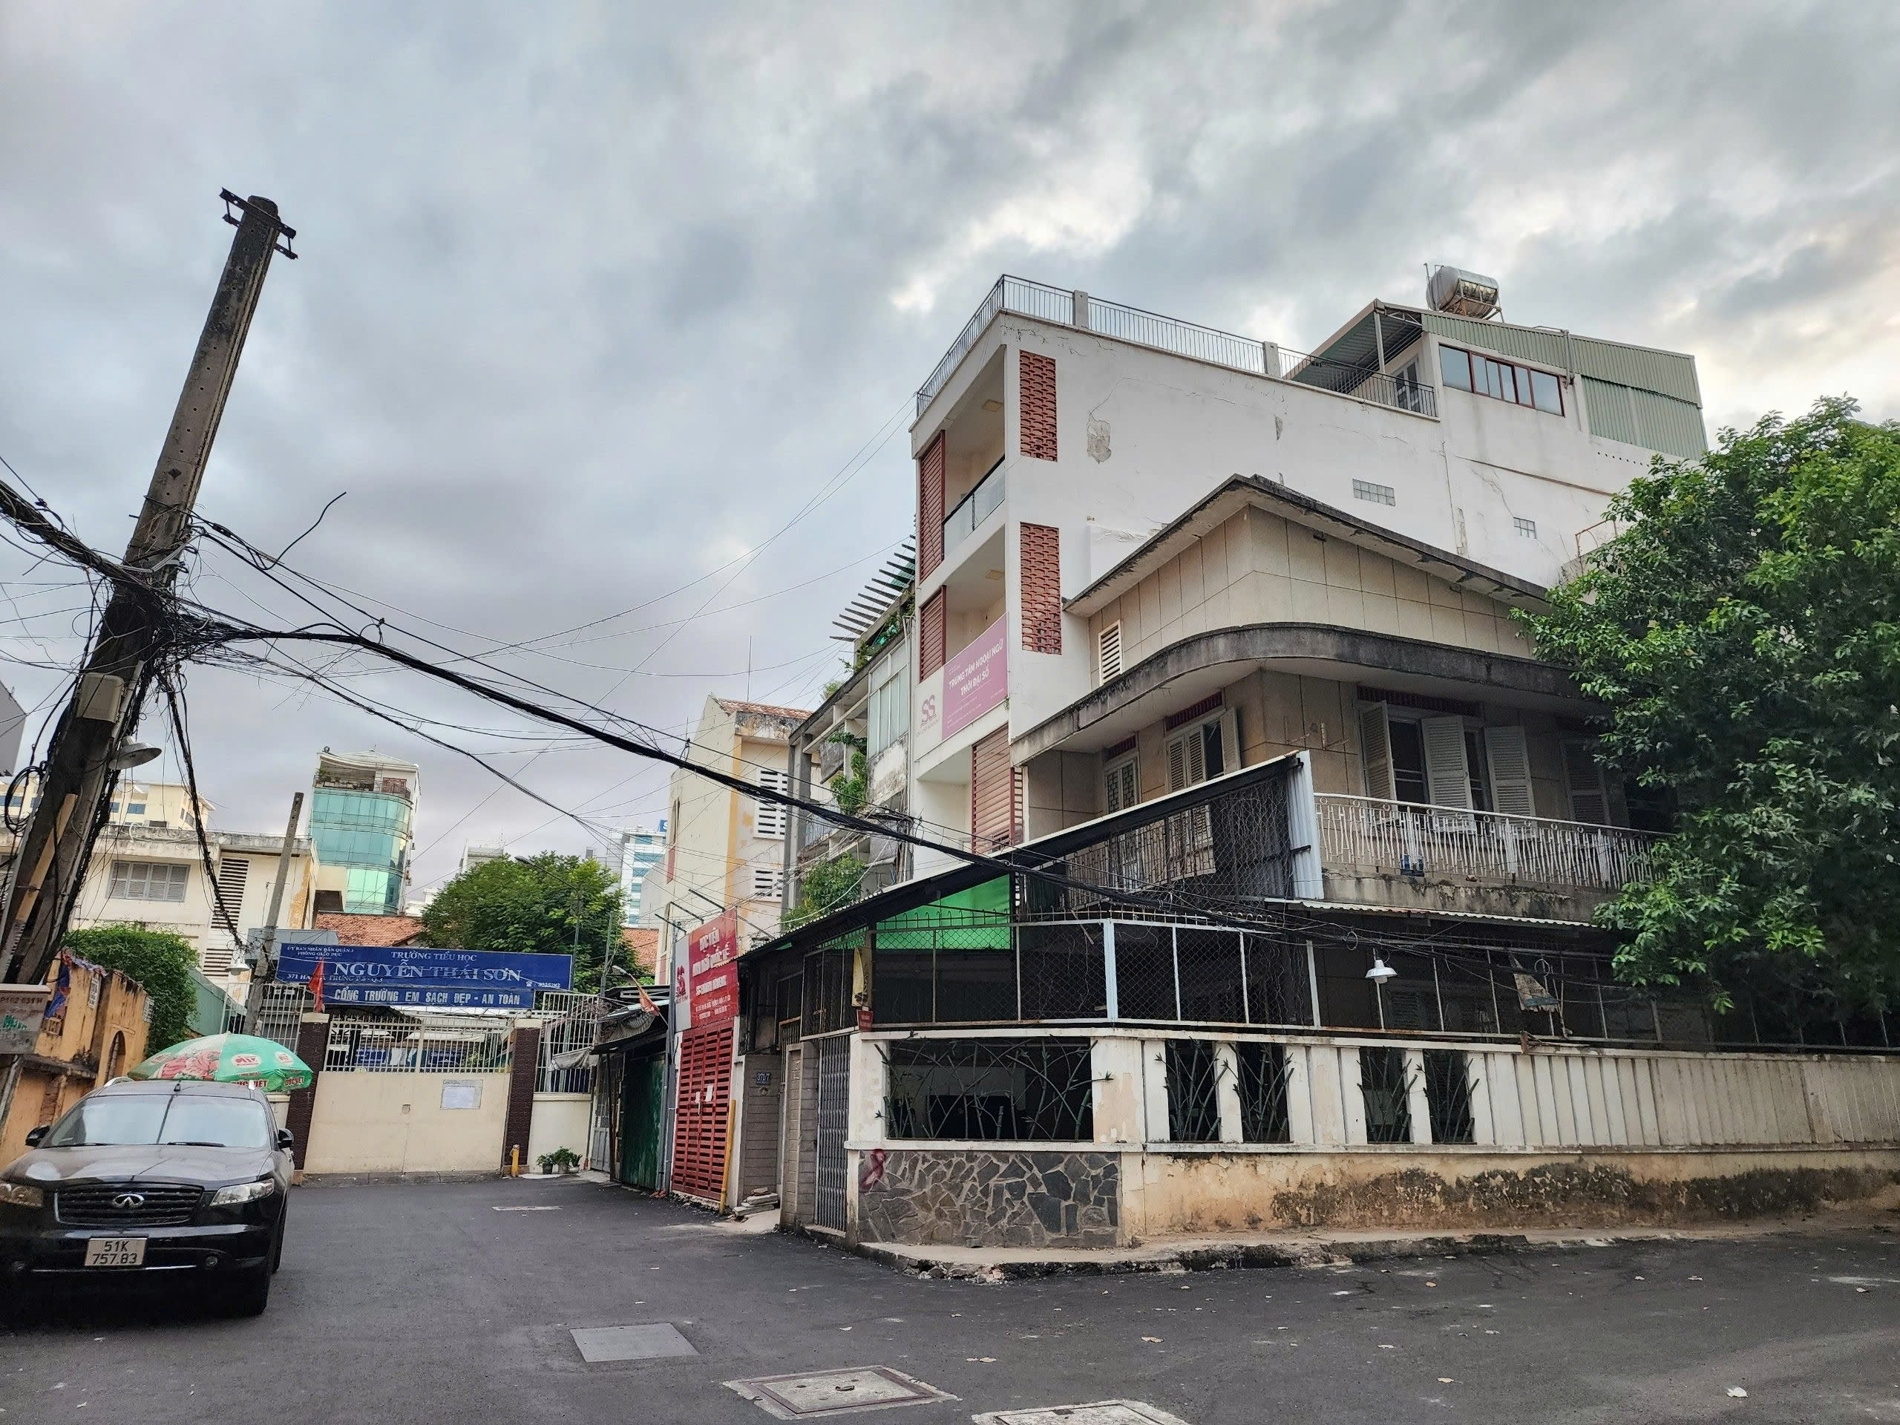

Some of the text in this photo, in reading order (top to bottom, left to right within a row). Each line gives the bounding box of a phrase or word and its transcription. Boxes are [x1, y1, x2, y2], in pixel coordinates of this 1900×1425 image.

[390, 951, 477, 963] TRƯỜNG TIỂU HỌC
[334, 959, 522, 982] NGUYỄN THÁI SƠN
[334, 986, 360, 1000] CỔNG
[364, 988, 399, 1002] TRƯỜNG
[405, 991, 420, 1002] EM
[425, 992, 448, 1005] SẠCH
[453, 993, 471, 1006] ĐẸP
[482, 994, 494, 1005] AN
[498, 993, 521, 1005] TOÀN
[104, 1241, 129, 1252] 51K
[93, 1253, 138, 1265] 757.83
